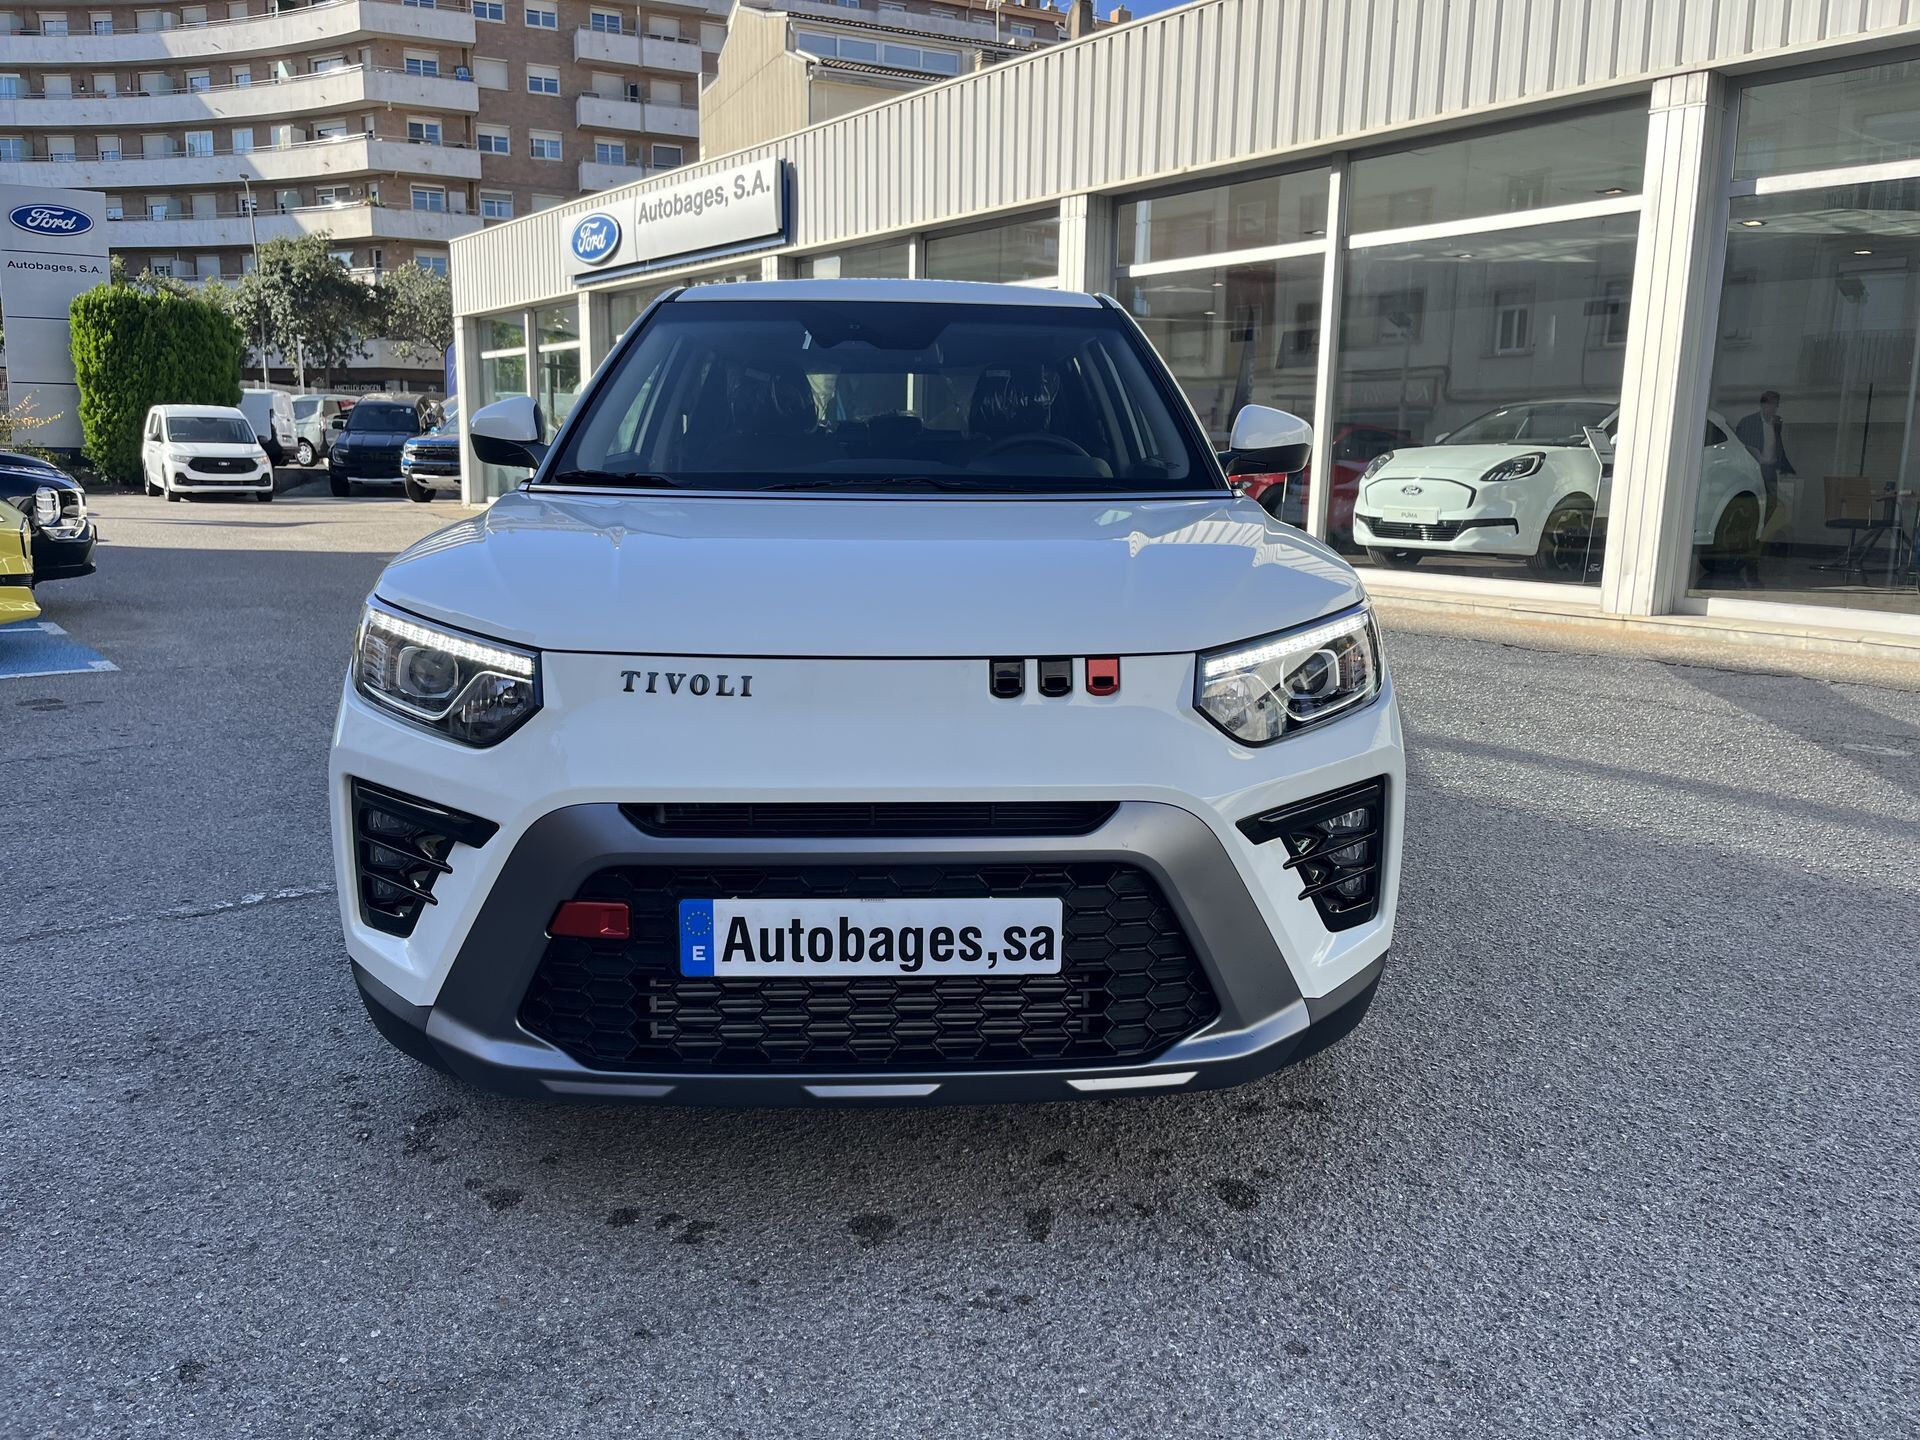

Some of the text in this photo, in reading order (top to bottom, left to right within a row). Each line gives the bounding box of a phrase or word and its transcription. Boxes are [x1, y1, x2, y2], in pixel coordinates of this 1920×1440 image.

[638, 170, 771, 225] Autobages, S.A.
[26, 207, 77, 231] Ford
[577, 221, 607, 254] Ford
[7, 260, 104, 275] Autobages, S.A.
[620, 669, 753, 698] TIVOLI
[692, 945, 706, 961] E
[721, 916, 1056, 972] Autobages,sa
